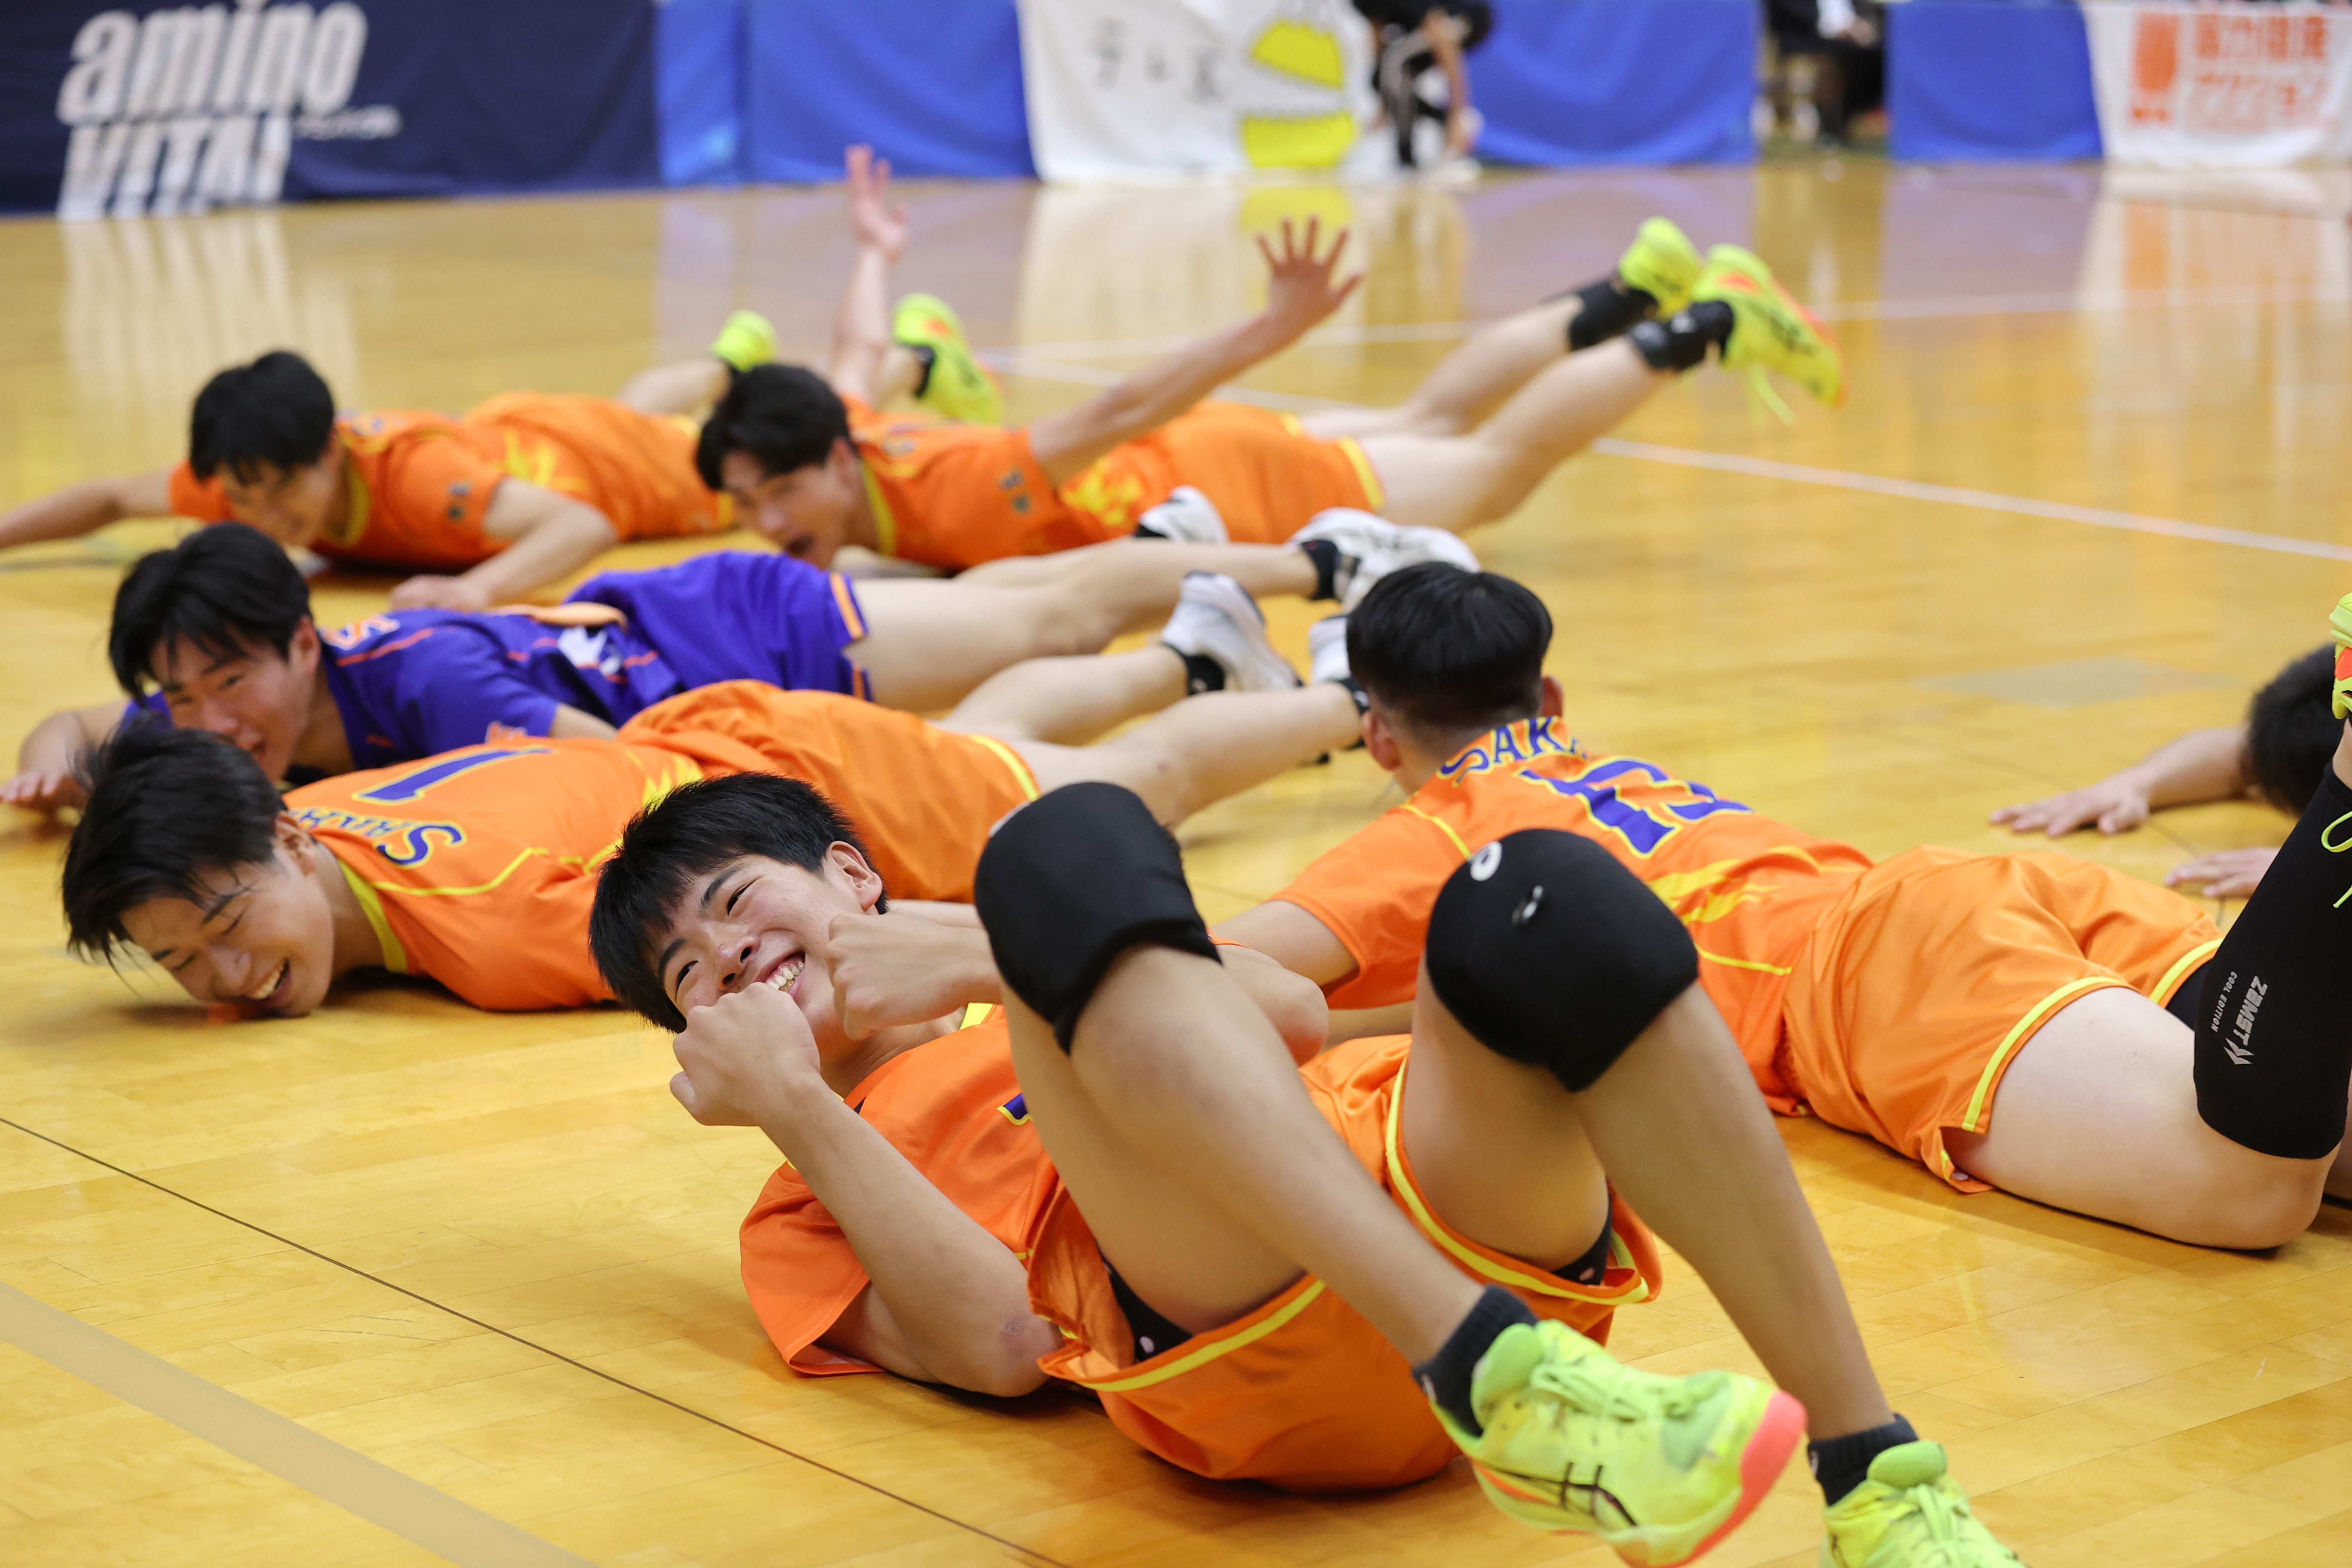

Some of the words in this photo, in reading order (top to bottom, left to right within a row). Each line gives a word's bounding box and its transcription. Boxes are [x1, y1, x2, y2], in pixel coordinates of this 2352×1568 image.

[56, 0, 369, 125] amino
[350, 744, 558, 805] 1
[2223, 971, 2238, 993] COOL
[2233, 975, 2269, 1046] ZAMST
[2211, 994, 2227, 1032] EDITION
